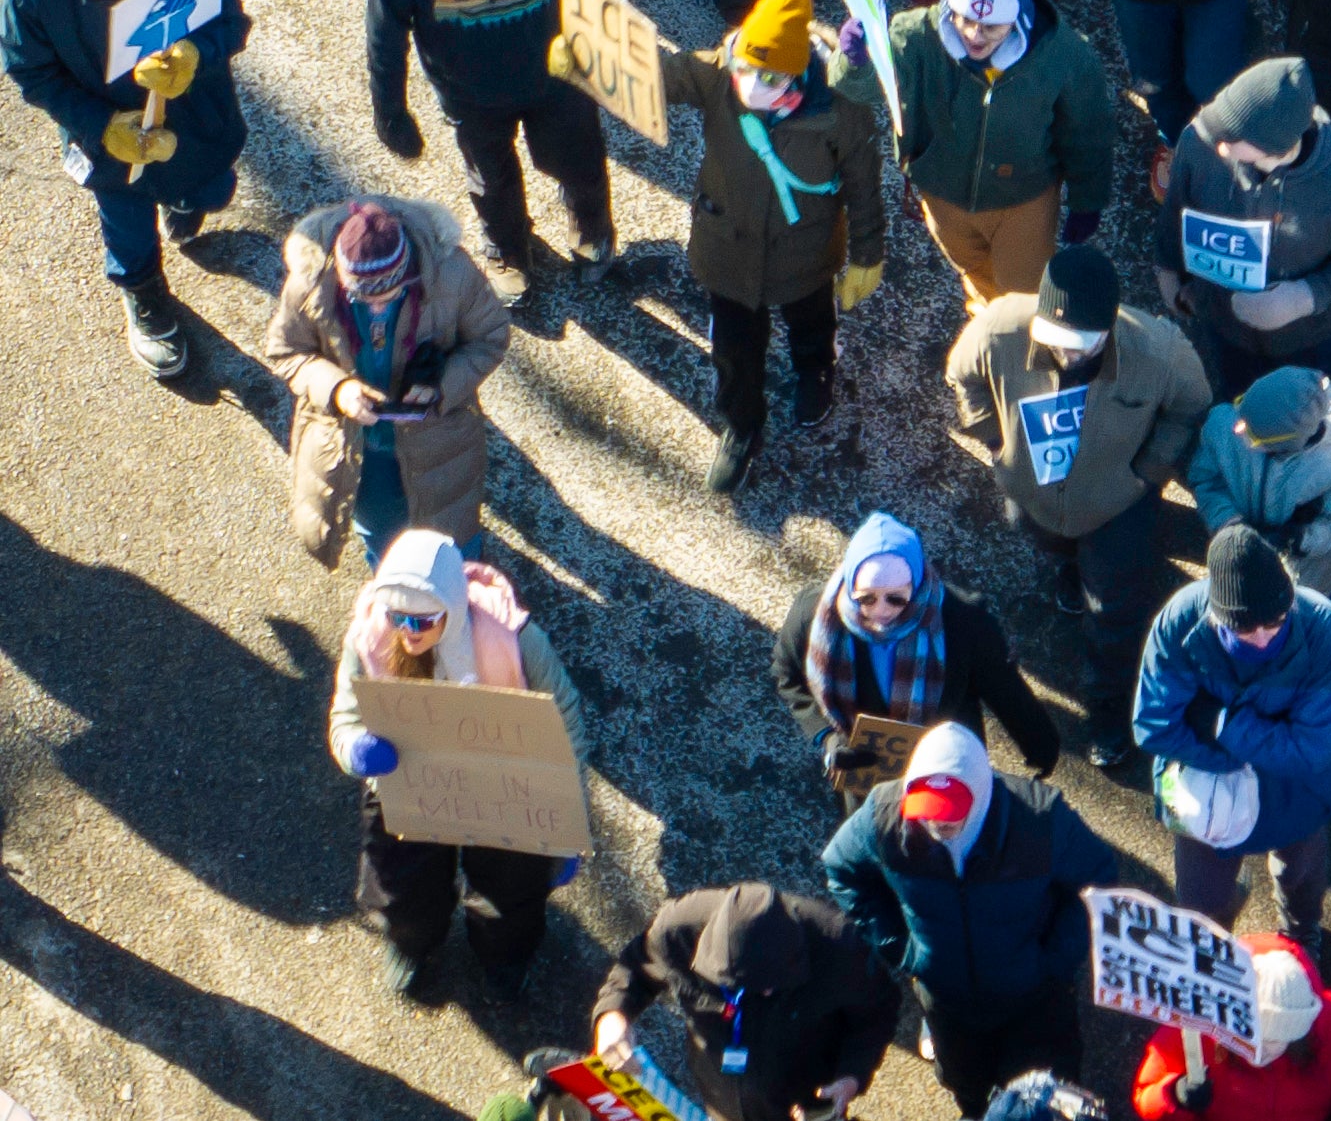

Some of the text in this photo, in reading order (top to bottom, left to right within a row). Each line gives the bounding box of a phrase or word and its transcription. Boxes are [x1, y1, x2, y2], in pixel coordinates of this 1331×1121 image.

[1201, 228, 1247, 257] ICE
[1193, 252, 1255, 285] OUT
[861, 730, 908, 755] IC
[401, 763, 468, 793] LOVE
[418, 796, 562, 830] MELT ICE
[1110, 895, 1236, 965] KILLER
[1102, 912, 1252, 994] ICE
[1102, 959, 1255, 1039] STREETS
